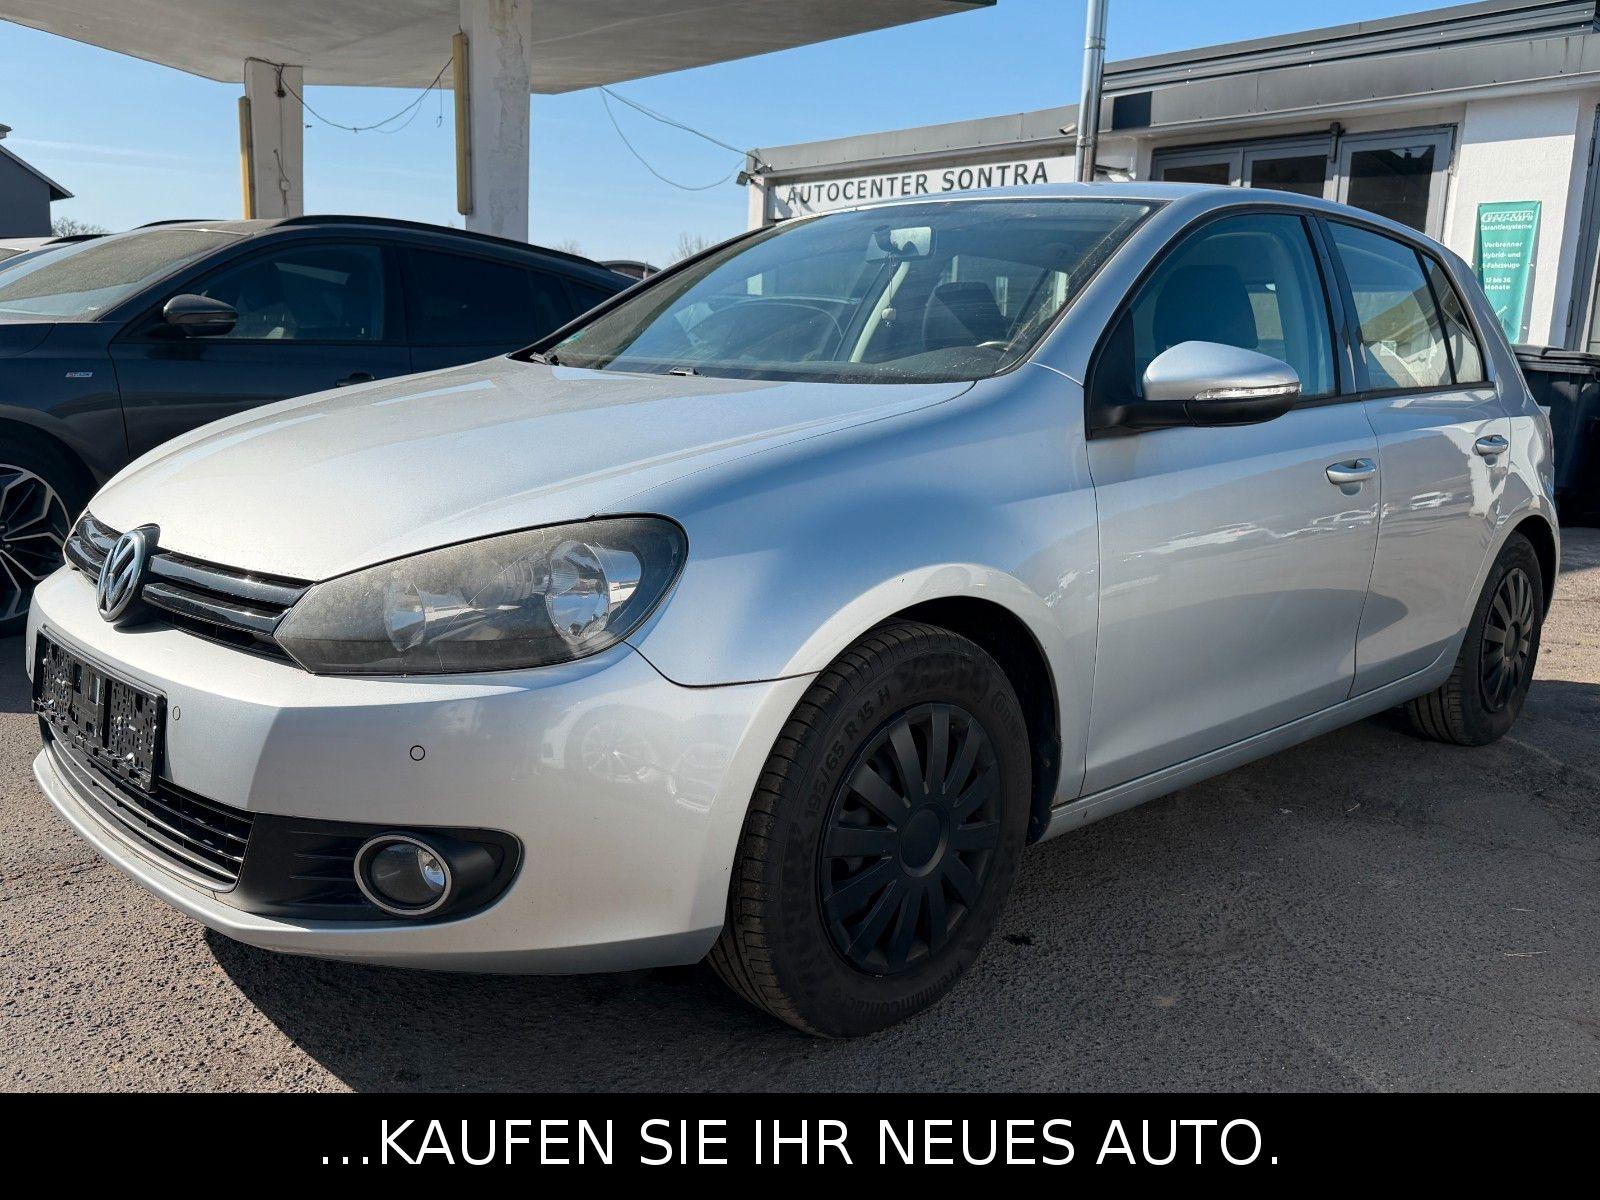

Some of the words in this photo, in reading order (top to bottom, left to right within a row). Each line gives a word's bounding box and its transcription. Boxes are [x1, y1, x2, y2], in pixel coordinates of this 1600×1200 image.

[786, 173, 929, 206] AUTOCENTER
[941, 161, 1049, 192] SONTRA
[1508, 251, 1521, 259] und
[1485, 283, 1511, 291] Monate
